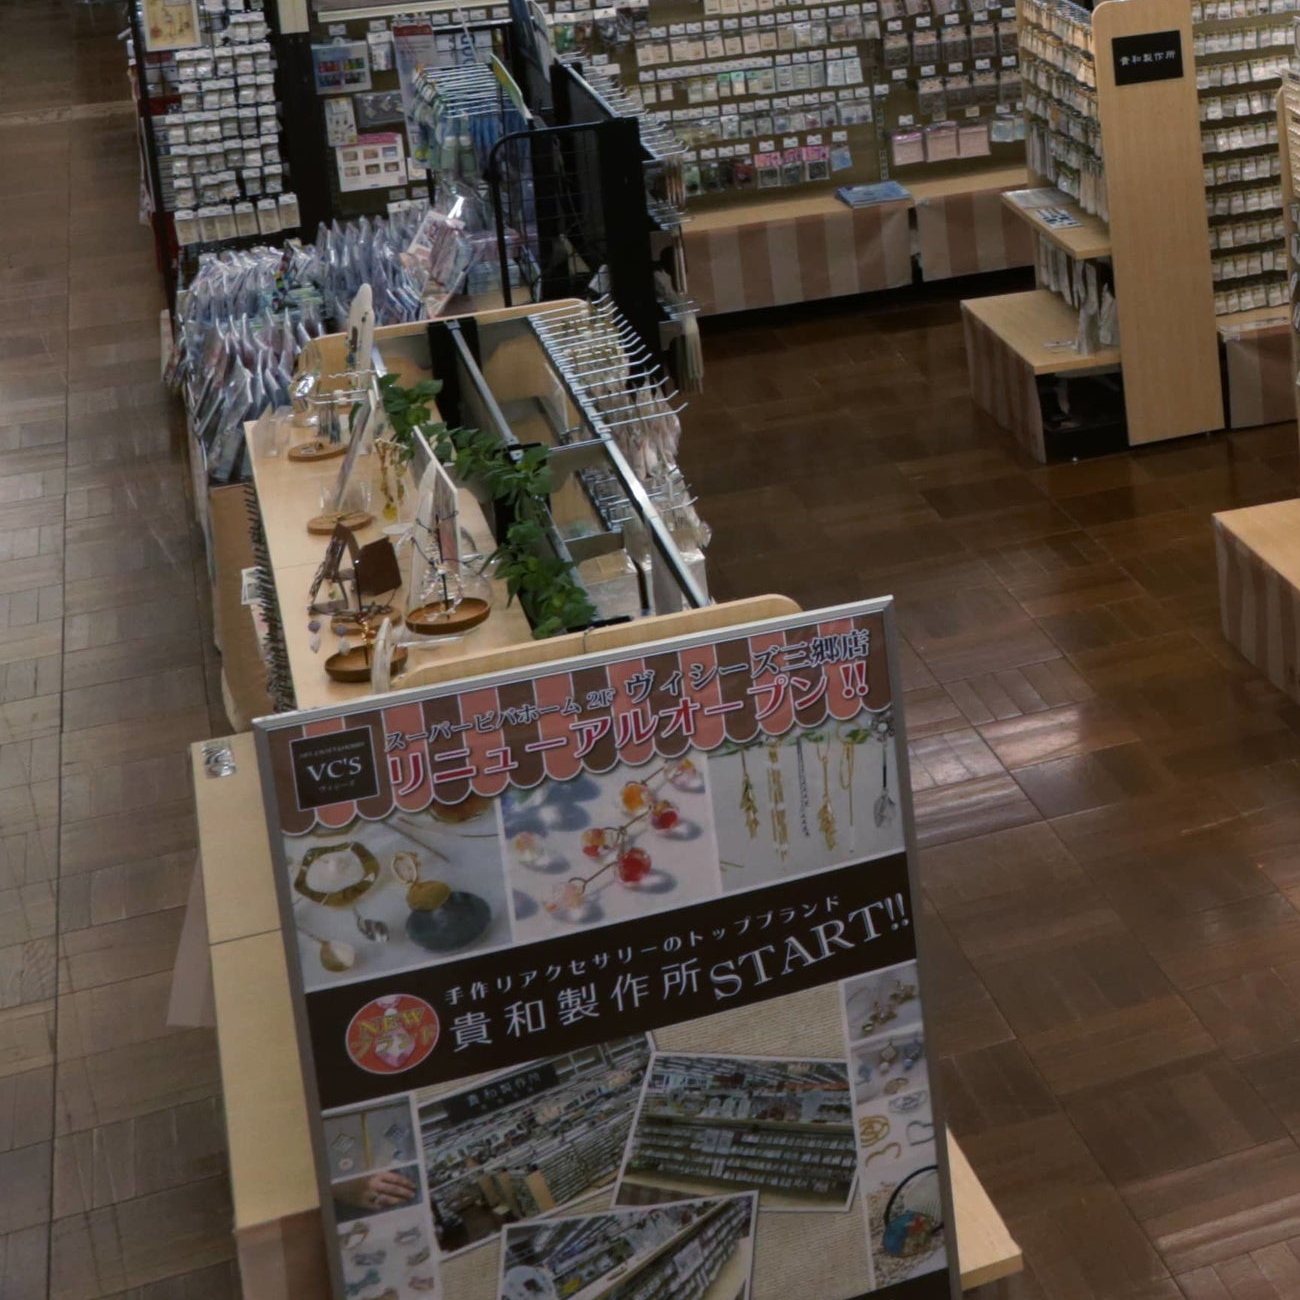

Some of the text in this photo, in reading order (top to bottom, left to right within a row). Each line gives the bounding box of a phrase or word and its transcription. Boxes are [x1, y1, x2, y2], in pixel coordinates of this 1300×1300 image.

[1119, 50, 1177, 68] 貴和製作所
[385, 628, 870, 751] スーパービバホーム 2F ヴィシーズ三郷店
[306, 754, 363, 783] VC'S
[445, 894, 841, 1007] 手作りアクセサリーのトップブランド
[707, 890, 912, 1002] START!!
[357, 1007, 425, 1038] NEW
[447, 956, 704, 1054] 貴和製作所
